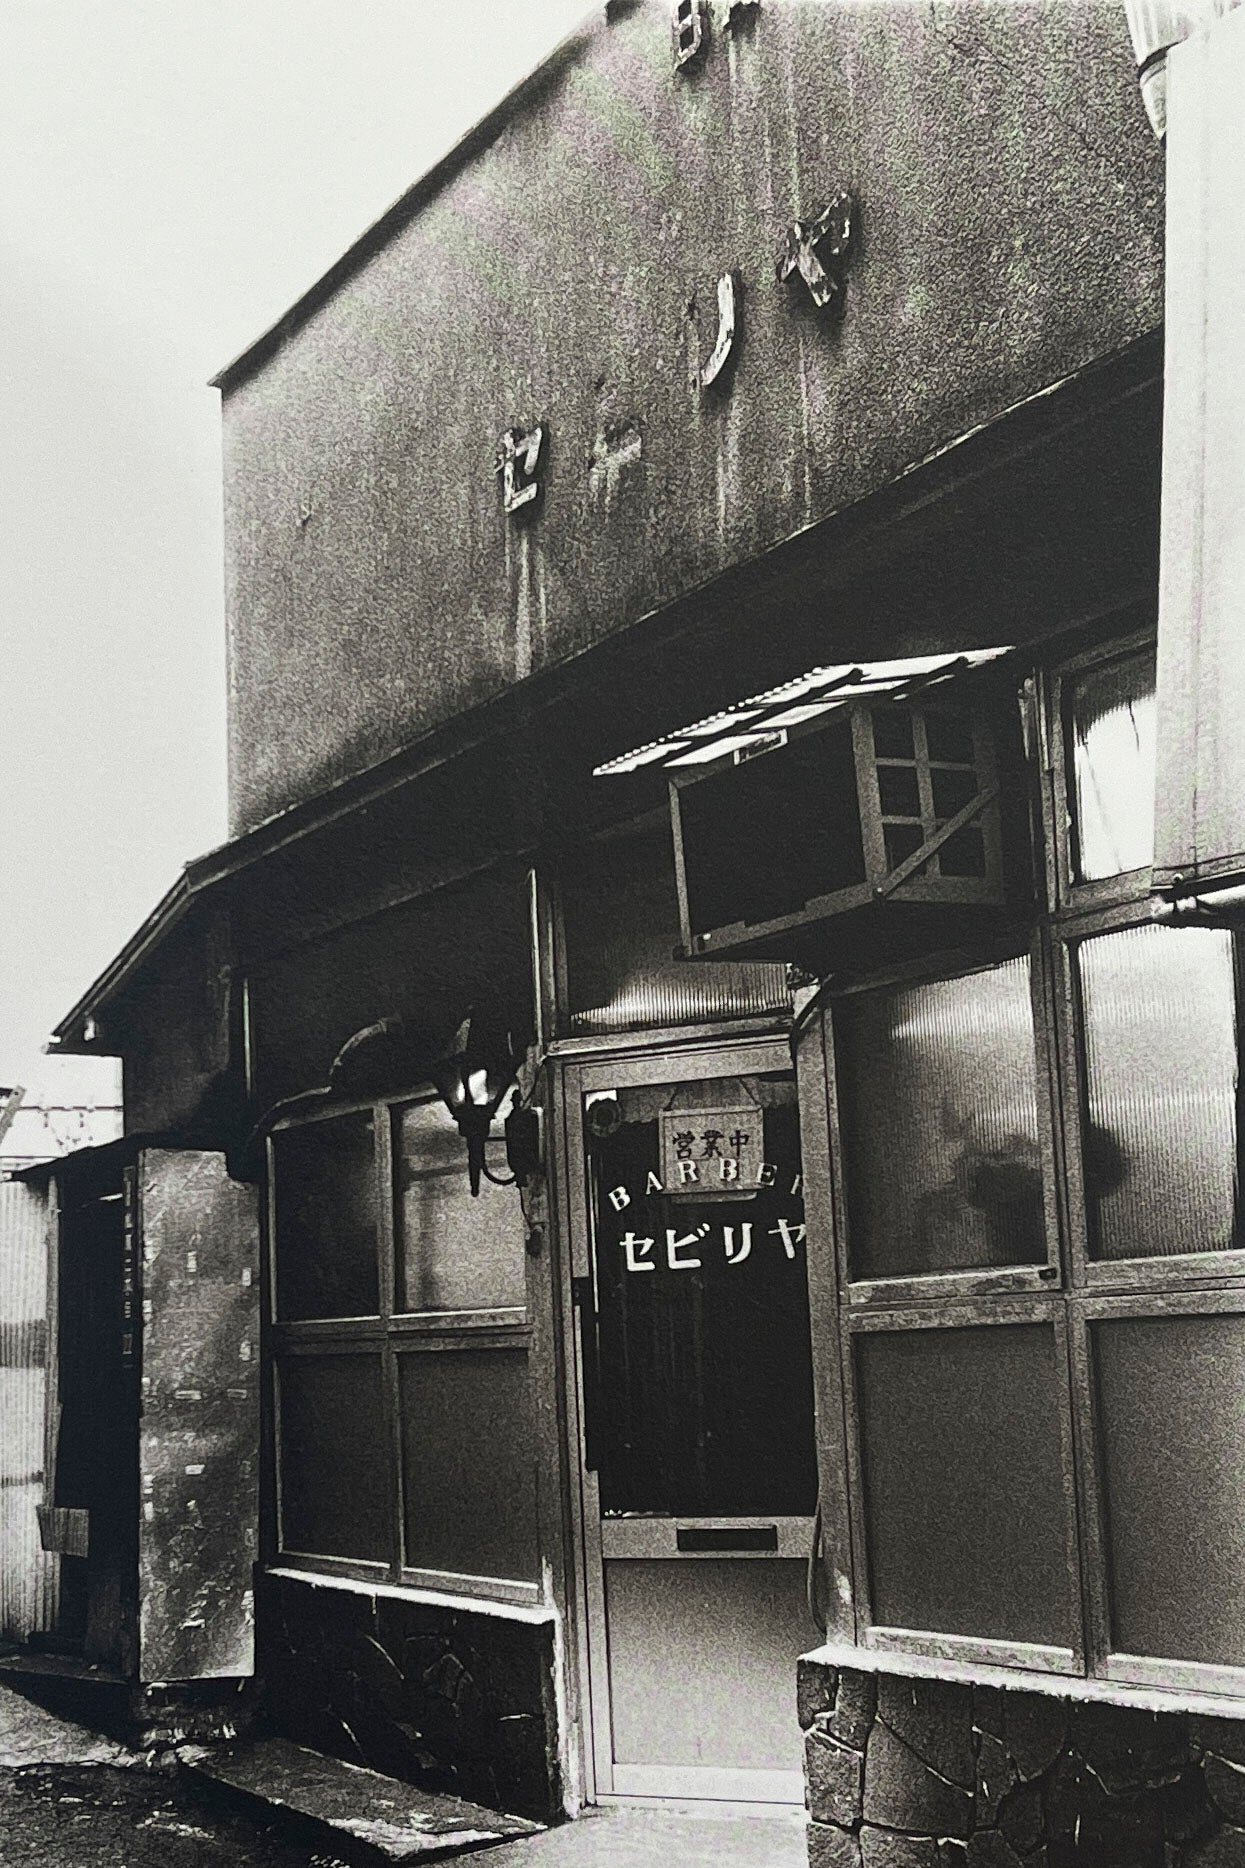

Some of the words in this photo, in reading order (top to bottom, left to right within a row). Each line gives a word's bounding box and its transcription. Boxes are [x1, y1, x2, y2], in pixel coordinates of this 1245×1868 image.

[672, 1129, 750, 1160] 営業中
[619, 1218, 807, 1272] セビリヤ
